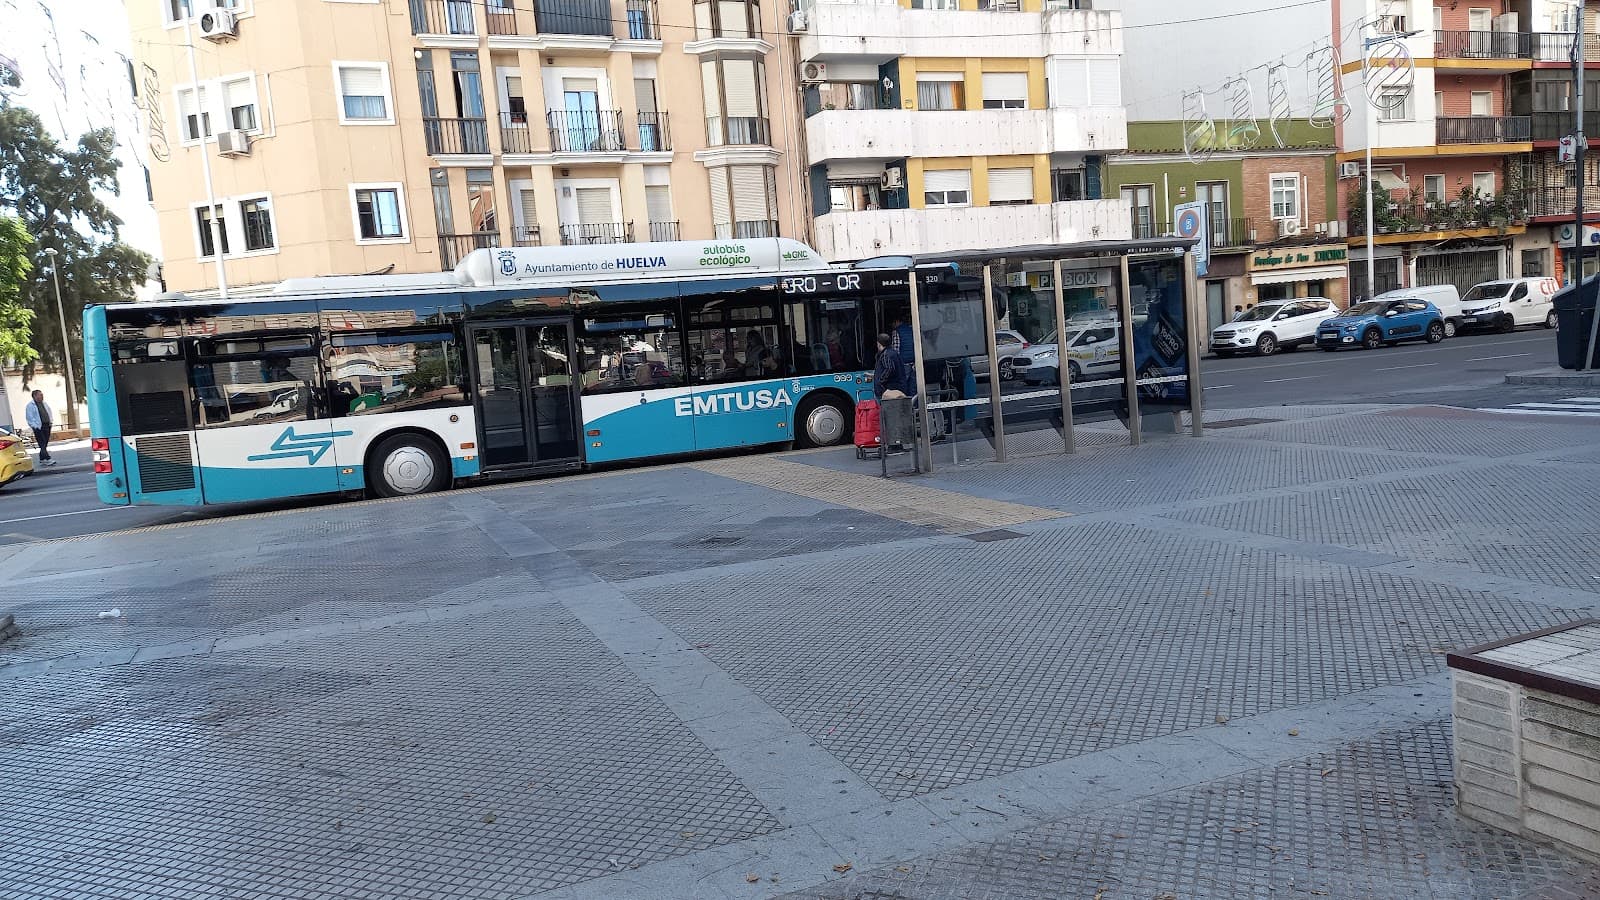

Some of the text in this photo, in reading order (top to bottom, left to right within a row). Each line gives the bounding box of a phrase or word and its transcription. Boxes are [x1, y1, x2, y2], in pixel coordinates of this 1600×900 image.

[703, 244, 746, 255] autobús
[525, 256, 667, 275] Ayuntamiento de HUELVA
[700, 254, 751, 267] ecológico
[674, 388, 793, 417] EMTUSA
